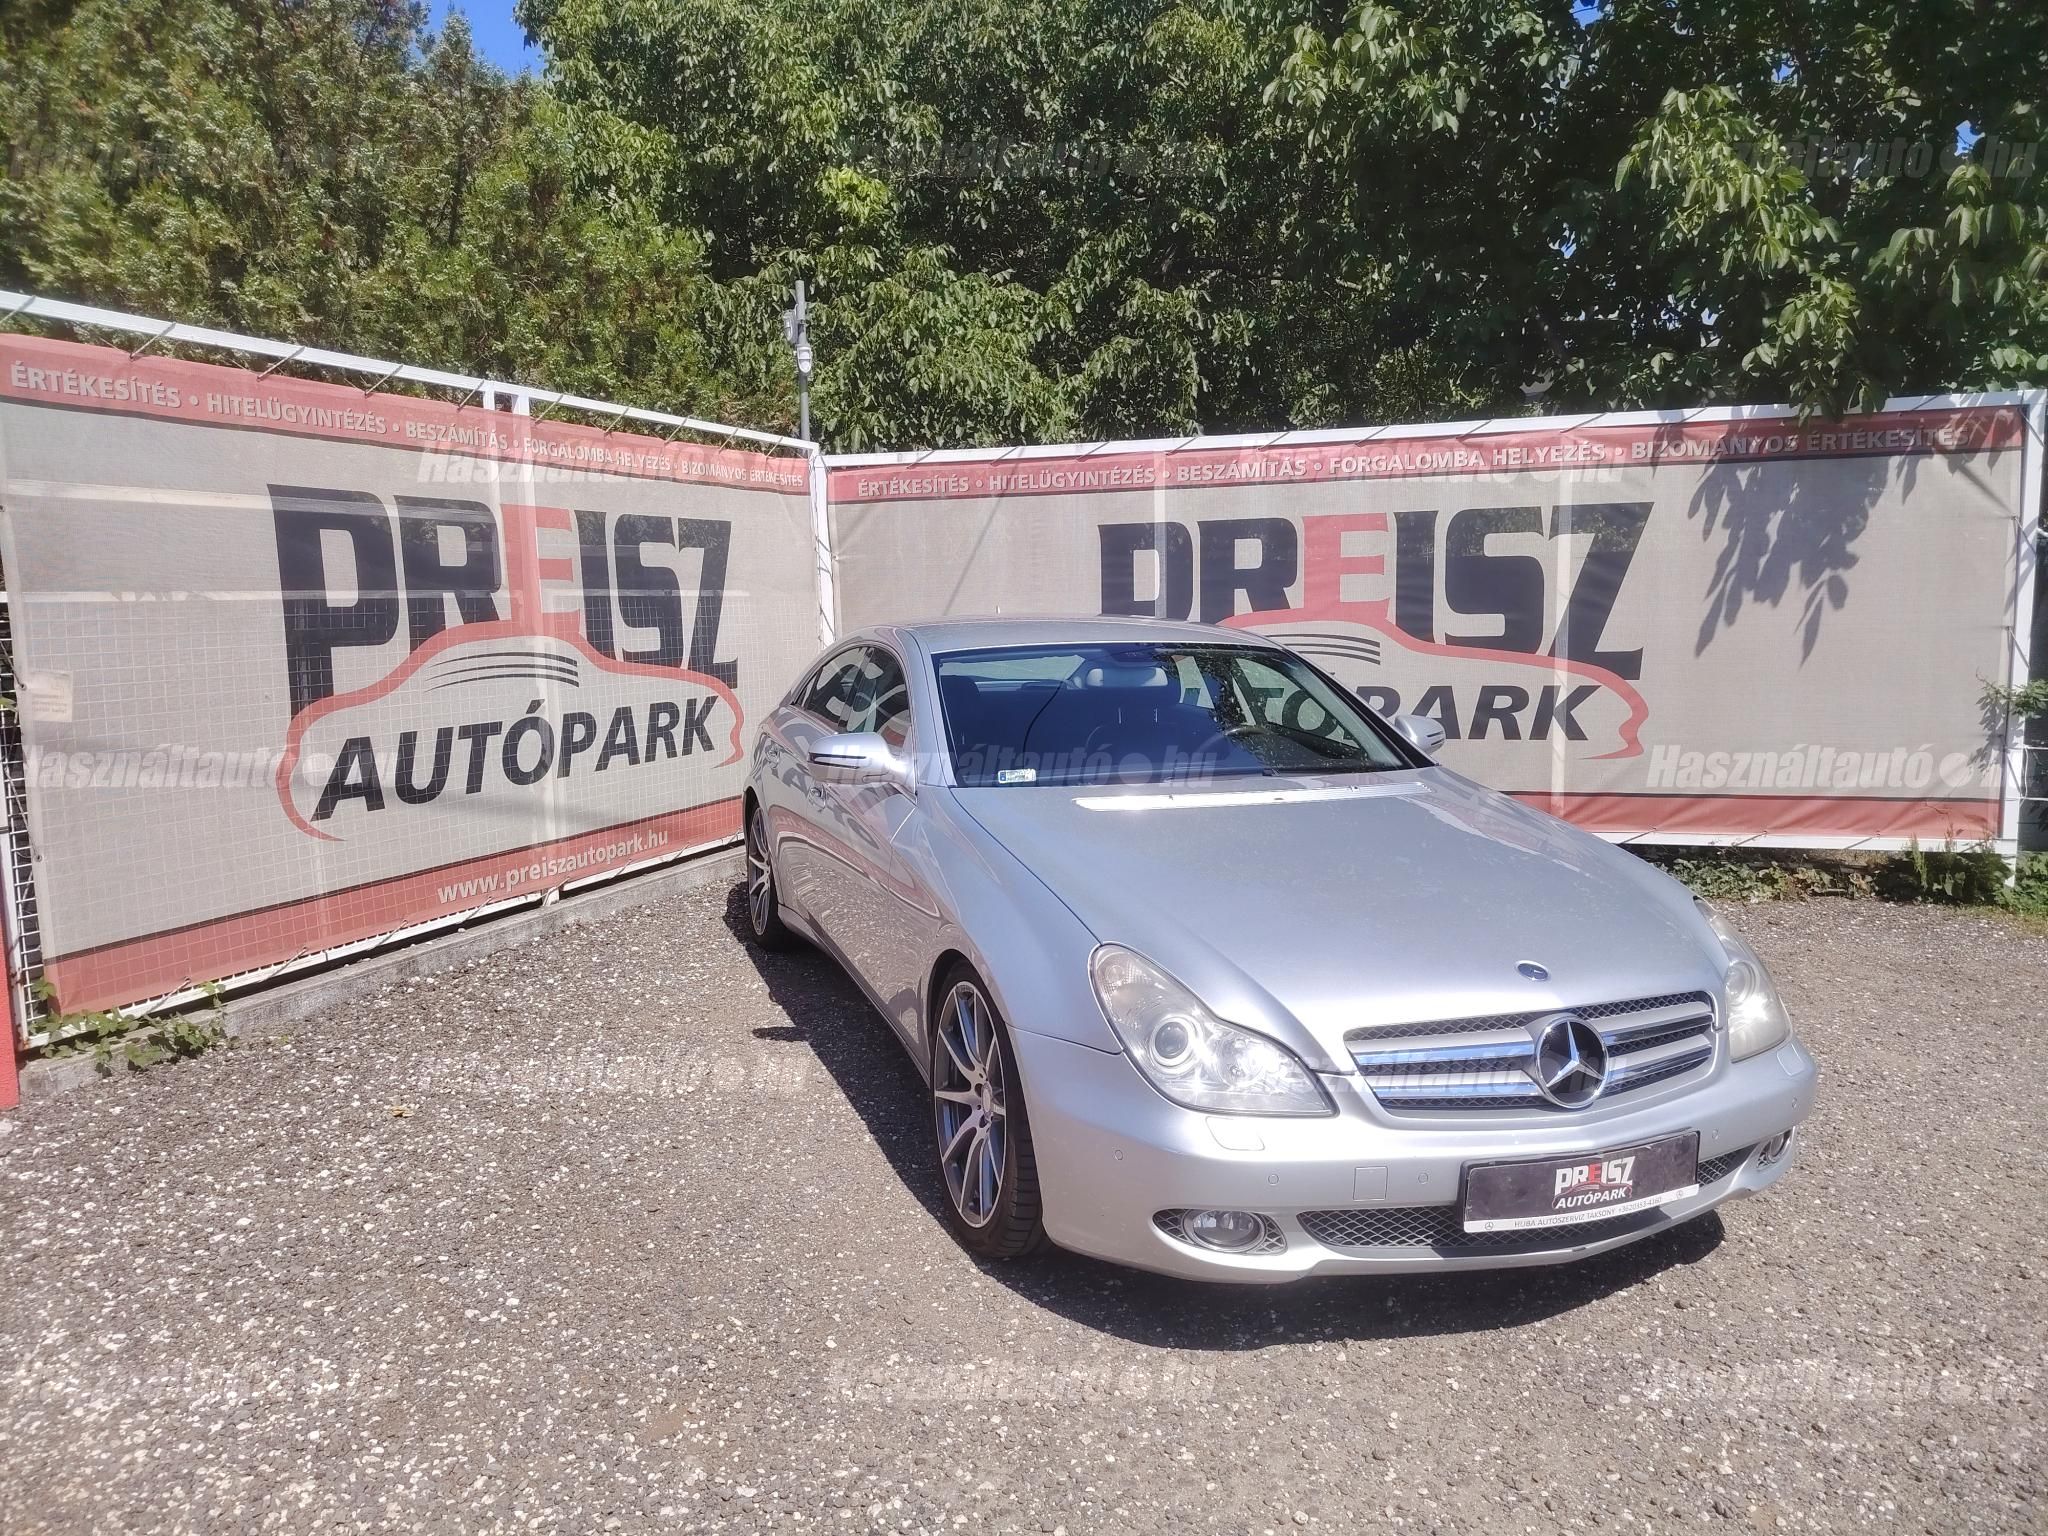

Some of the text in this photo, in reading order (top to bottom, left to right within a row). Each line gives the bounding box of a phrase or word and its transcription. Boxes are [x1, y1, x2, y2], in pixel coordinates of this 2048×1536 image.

[10, 360, 183, 409] ÉRTÉKESÍTÉS
[207, 392, 388, 434] HITELÜGYINTÉZÉS
[406, 421, 508, 450] BESZÁMÍTÁS
[523, 437, 614, 464] FORGALOMBA
[615, 452, 672, 473] HELYEZÉS
[681, 459, 748, 483] BIZOMÁNYOS
[749, 467, 804, 487] ÉRTÉKESÍTÉS
[857, 423, 1970, 498] ÉRTÉKESÍTÉS HITELÜGYINTÉZÉS BESZÁMÍTÁS FORGALOMBA HELYEZÉS BIZOMÁNYOS ÉRTÉKESÍTÉS
[267, 484, 739, 718] PREISZ
[1098, 502, 1654, 680] PREISZ
[310, 696, 719, 822] AUTÓPARK
[438, 830, 668, 903] www.preiszautopark.hu
[1555, 1156, 1634, 1196] PREISZ
[1555, 1187, 1627, 1209] AUTÓPARK
[1514, 1220, 1536, 1228] HUBA
[1537, 1214, 1585, 1226] AUTÓSZERVIZ
[1587, 1208, 1616, 1220] TAKSONY
